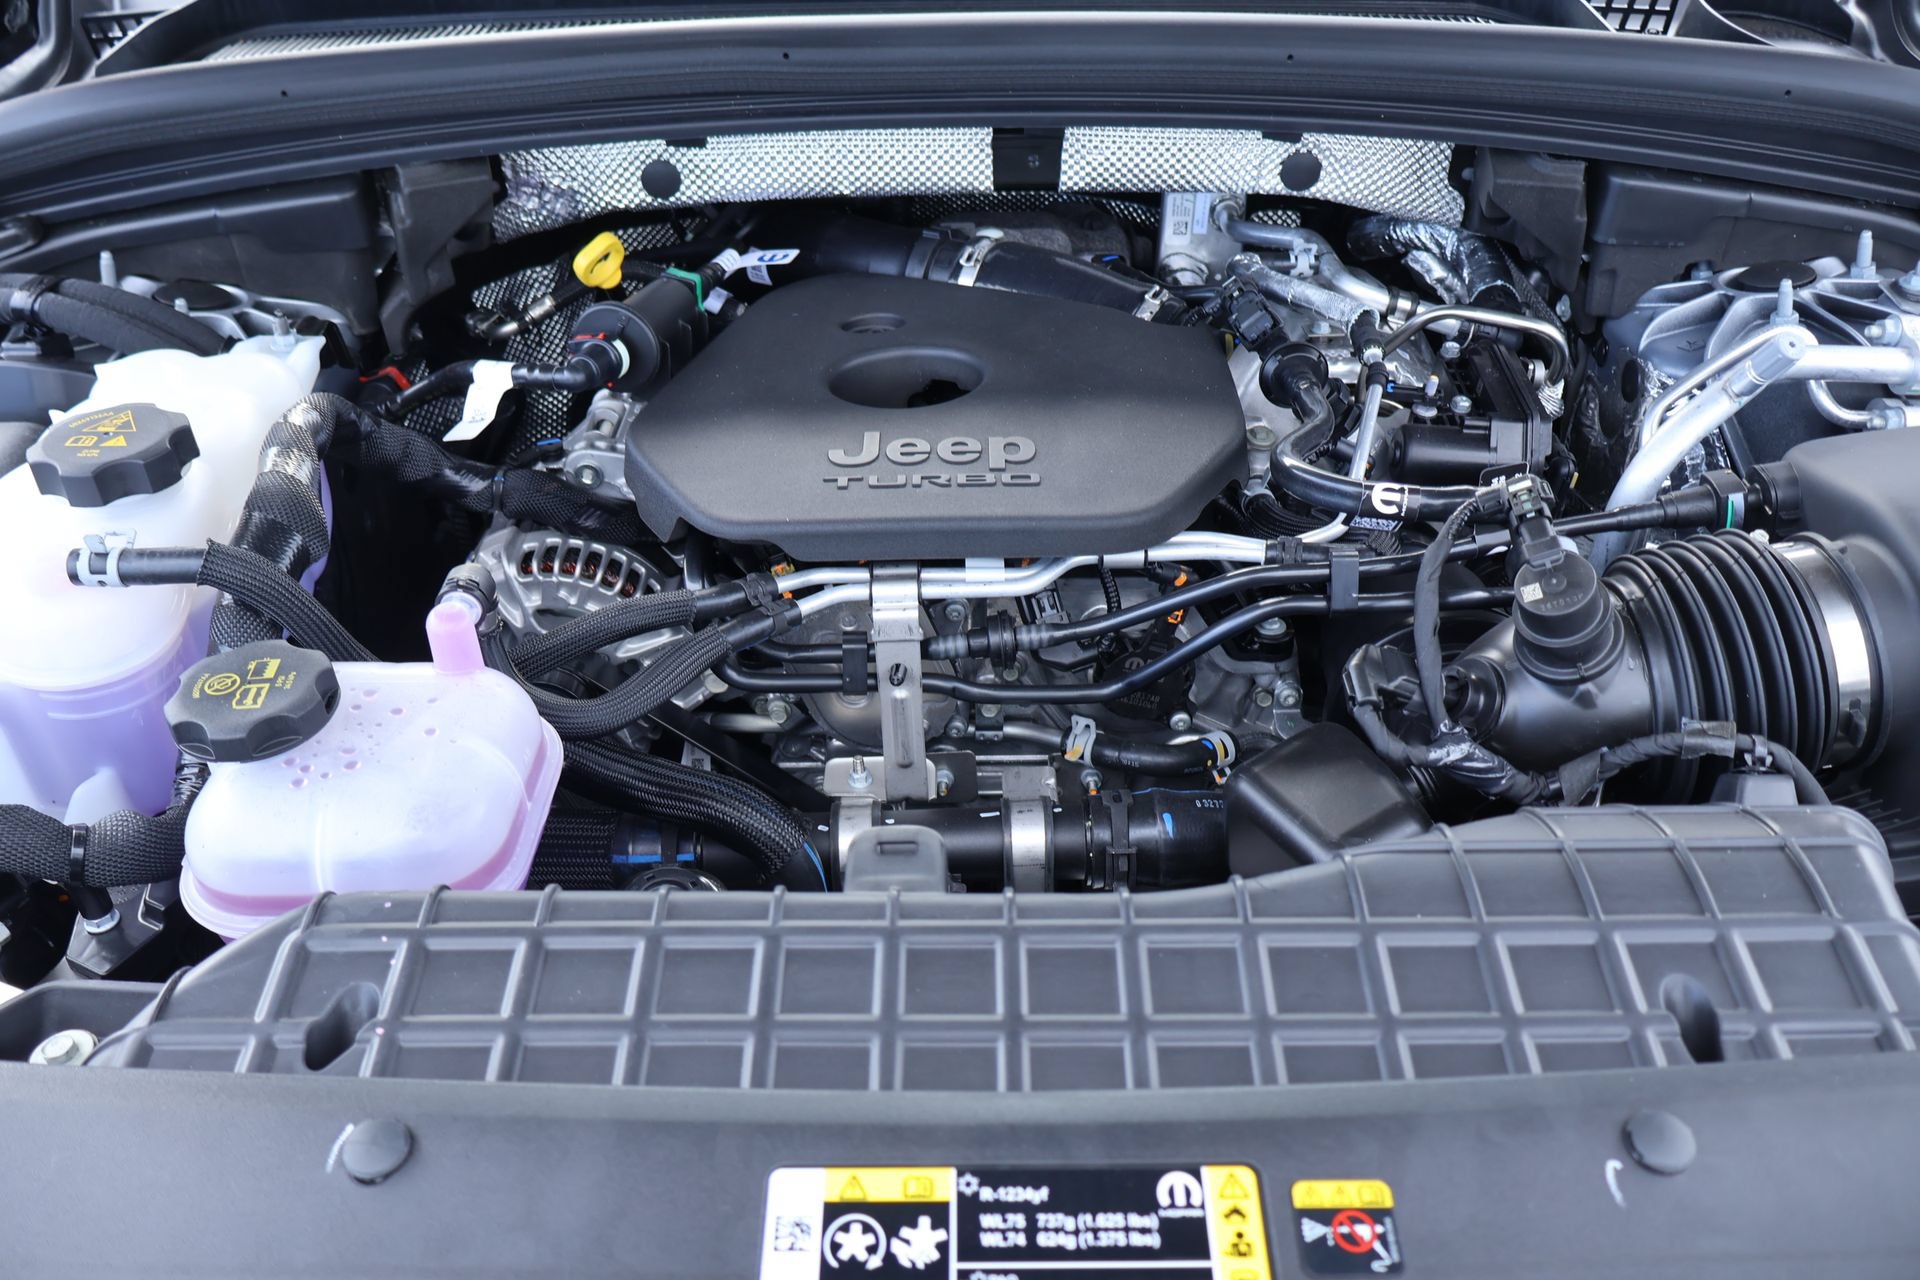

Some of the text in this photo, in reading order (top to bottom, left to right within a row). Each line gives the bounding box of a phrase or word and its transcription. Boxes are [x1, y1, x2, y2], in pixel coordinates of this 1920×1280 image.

[828, 431, 1036, 471] Jeep
[823, 473, 1041, 490] TURBO
[979, 1186, 1050, 1205] R-1234yf
[1036, 1213, 1076, 1231] 737g
